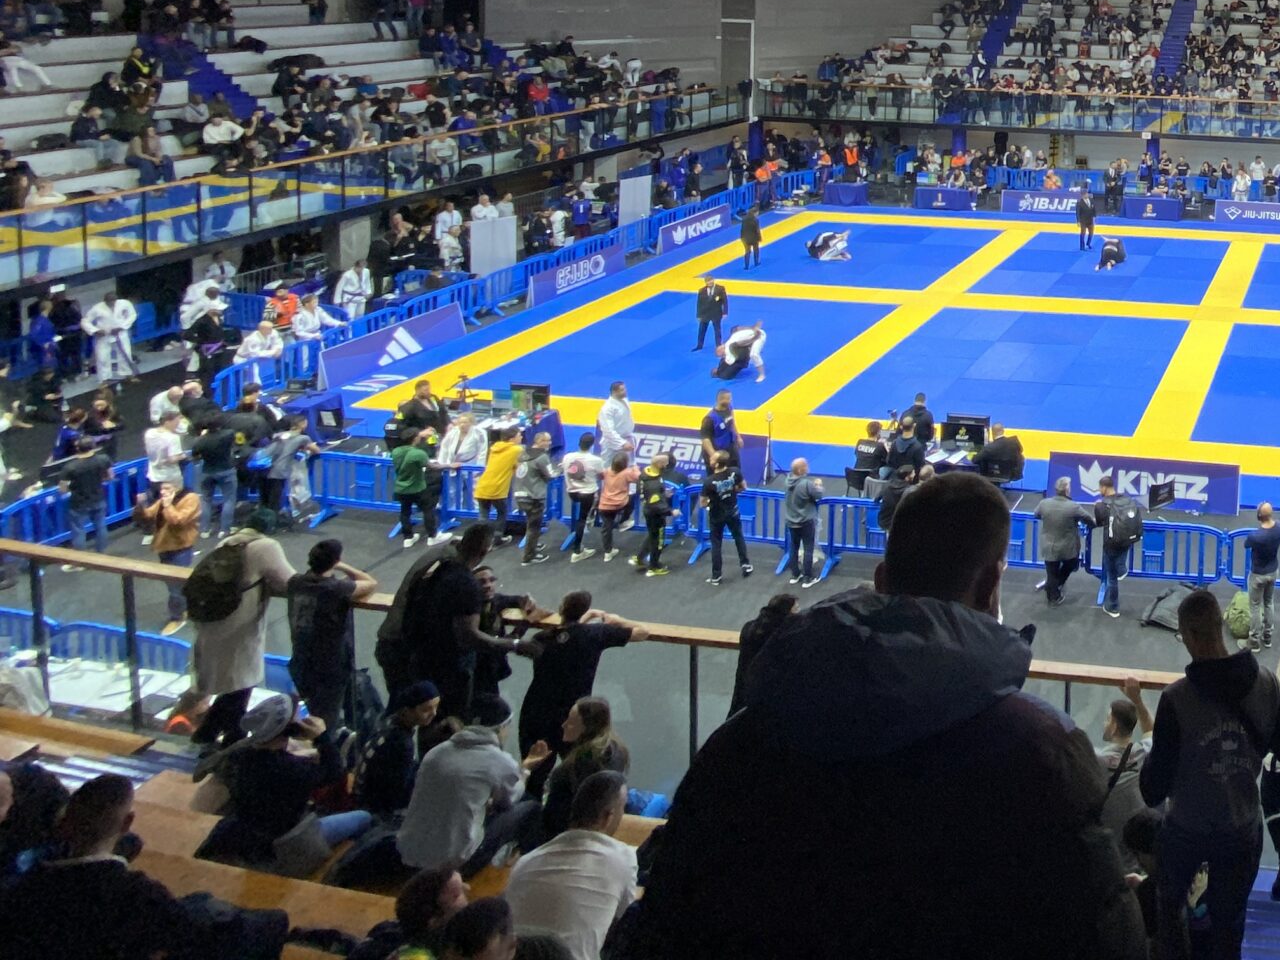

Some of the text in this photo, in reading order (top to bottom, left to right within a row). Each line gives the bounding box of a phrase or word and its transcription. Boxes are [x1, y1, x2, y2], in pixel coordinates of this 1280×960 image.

[1033, 197, 1078, 211] IBJJF
[1242, 210, 1280, 221] JIU-JITSU
[556, 259, 590, 289] CFJJB
[633, 432, 704, 462] Tata
[857, 444, 876, 454] CREW
